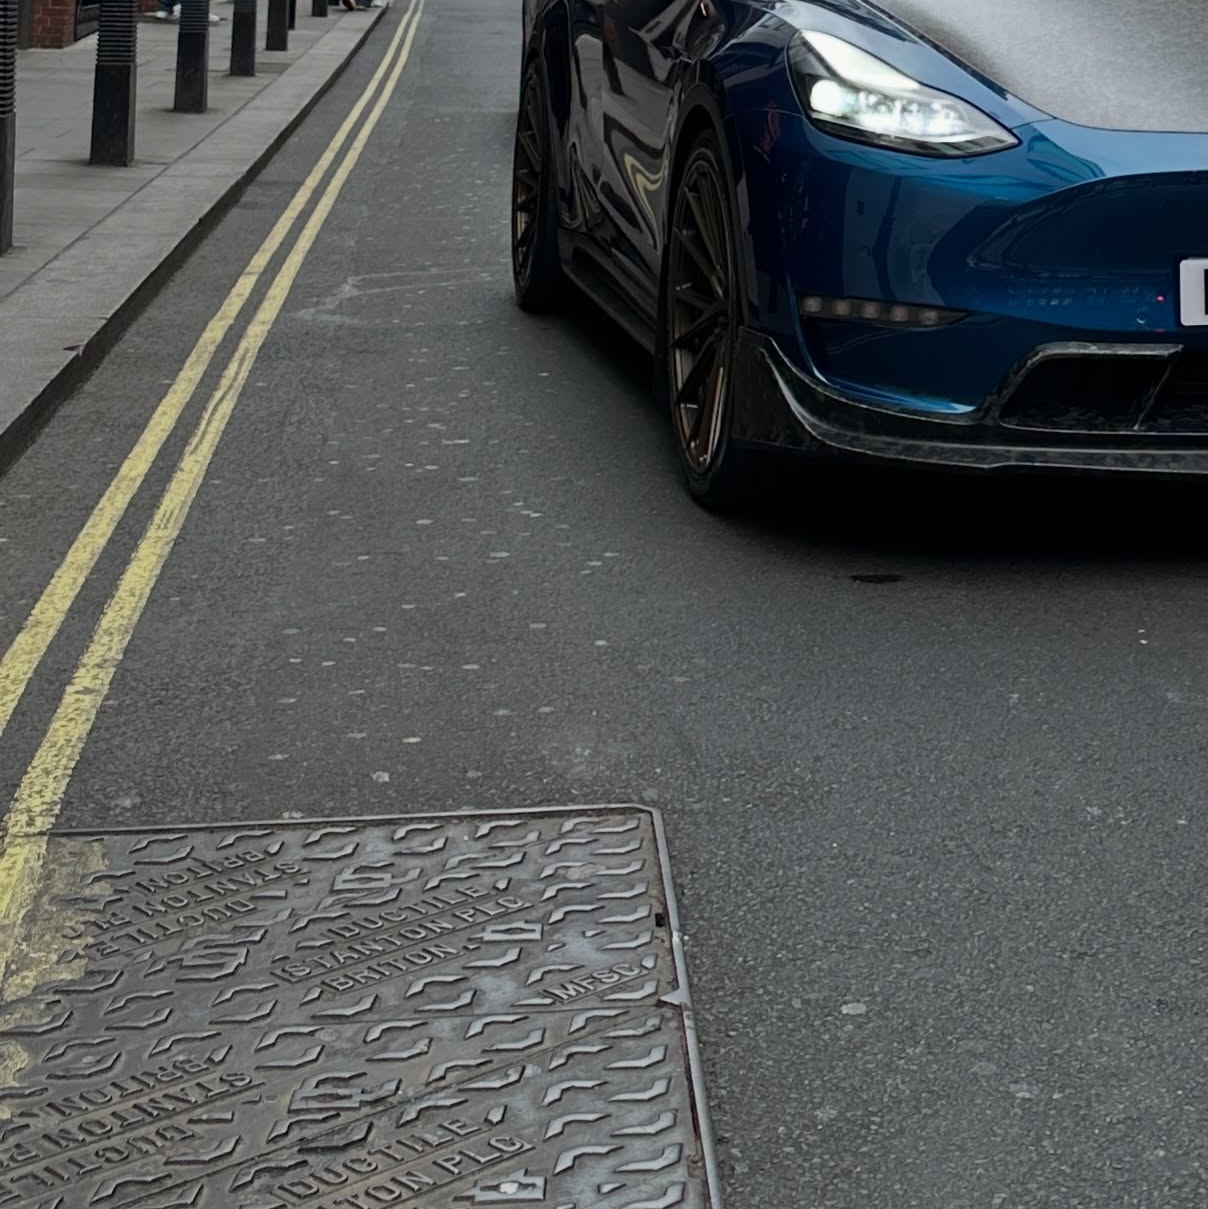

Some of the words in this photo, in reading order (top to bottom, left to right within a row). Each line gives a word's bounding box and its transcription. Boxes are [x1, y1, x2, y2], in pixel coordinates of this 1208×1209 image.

[281, 919, 456, 978] STANTON
[452, 896, 526, 923] PLC
[327, 886, 490, 938] DUCTILE
[321, 943, 460, 992] BRITON
[547, 963, 642, 1000] MFSC
[276, 1118, 481, 1199] DUCTILE
[431, 1135, 526, 1176] PLC
